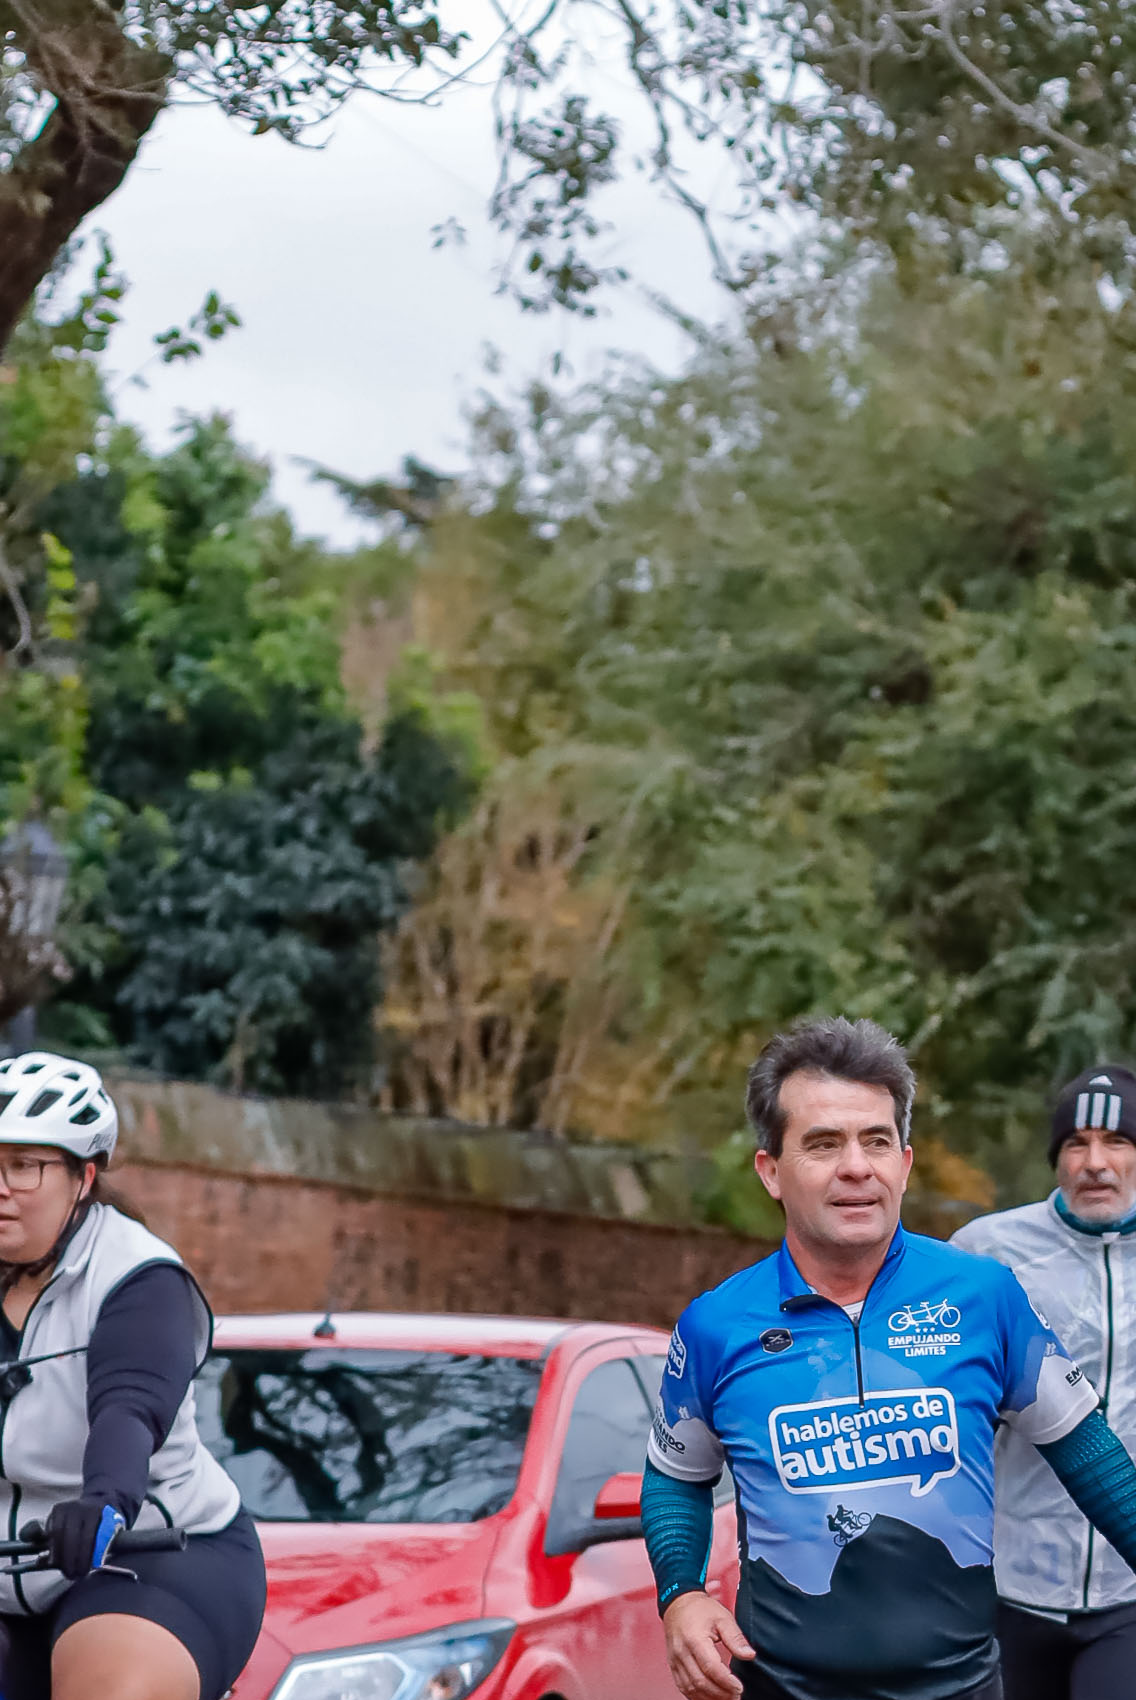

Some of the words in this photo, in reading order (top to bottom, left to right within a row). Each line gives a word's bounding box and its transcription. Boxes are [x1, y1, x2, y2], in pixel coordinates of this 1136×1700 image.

[888, 1333, 961, 1346] EMPUJANDO
[905, 1346, 946, 1357] LIMITES
[781, 1403, 908, 1445] hablemos
[912, 1393, 944, 1418] de
[780, 1425, 956, 1480] autismo
